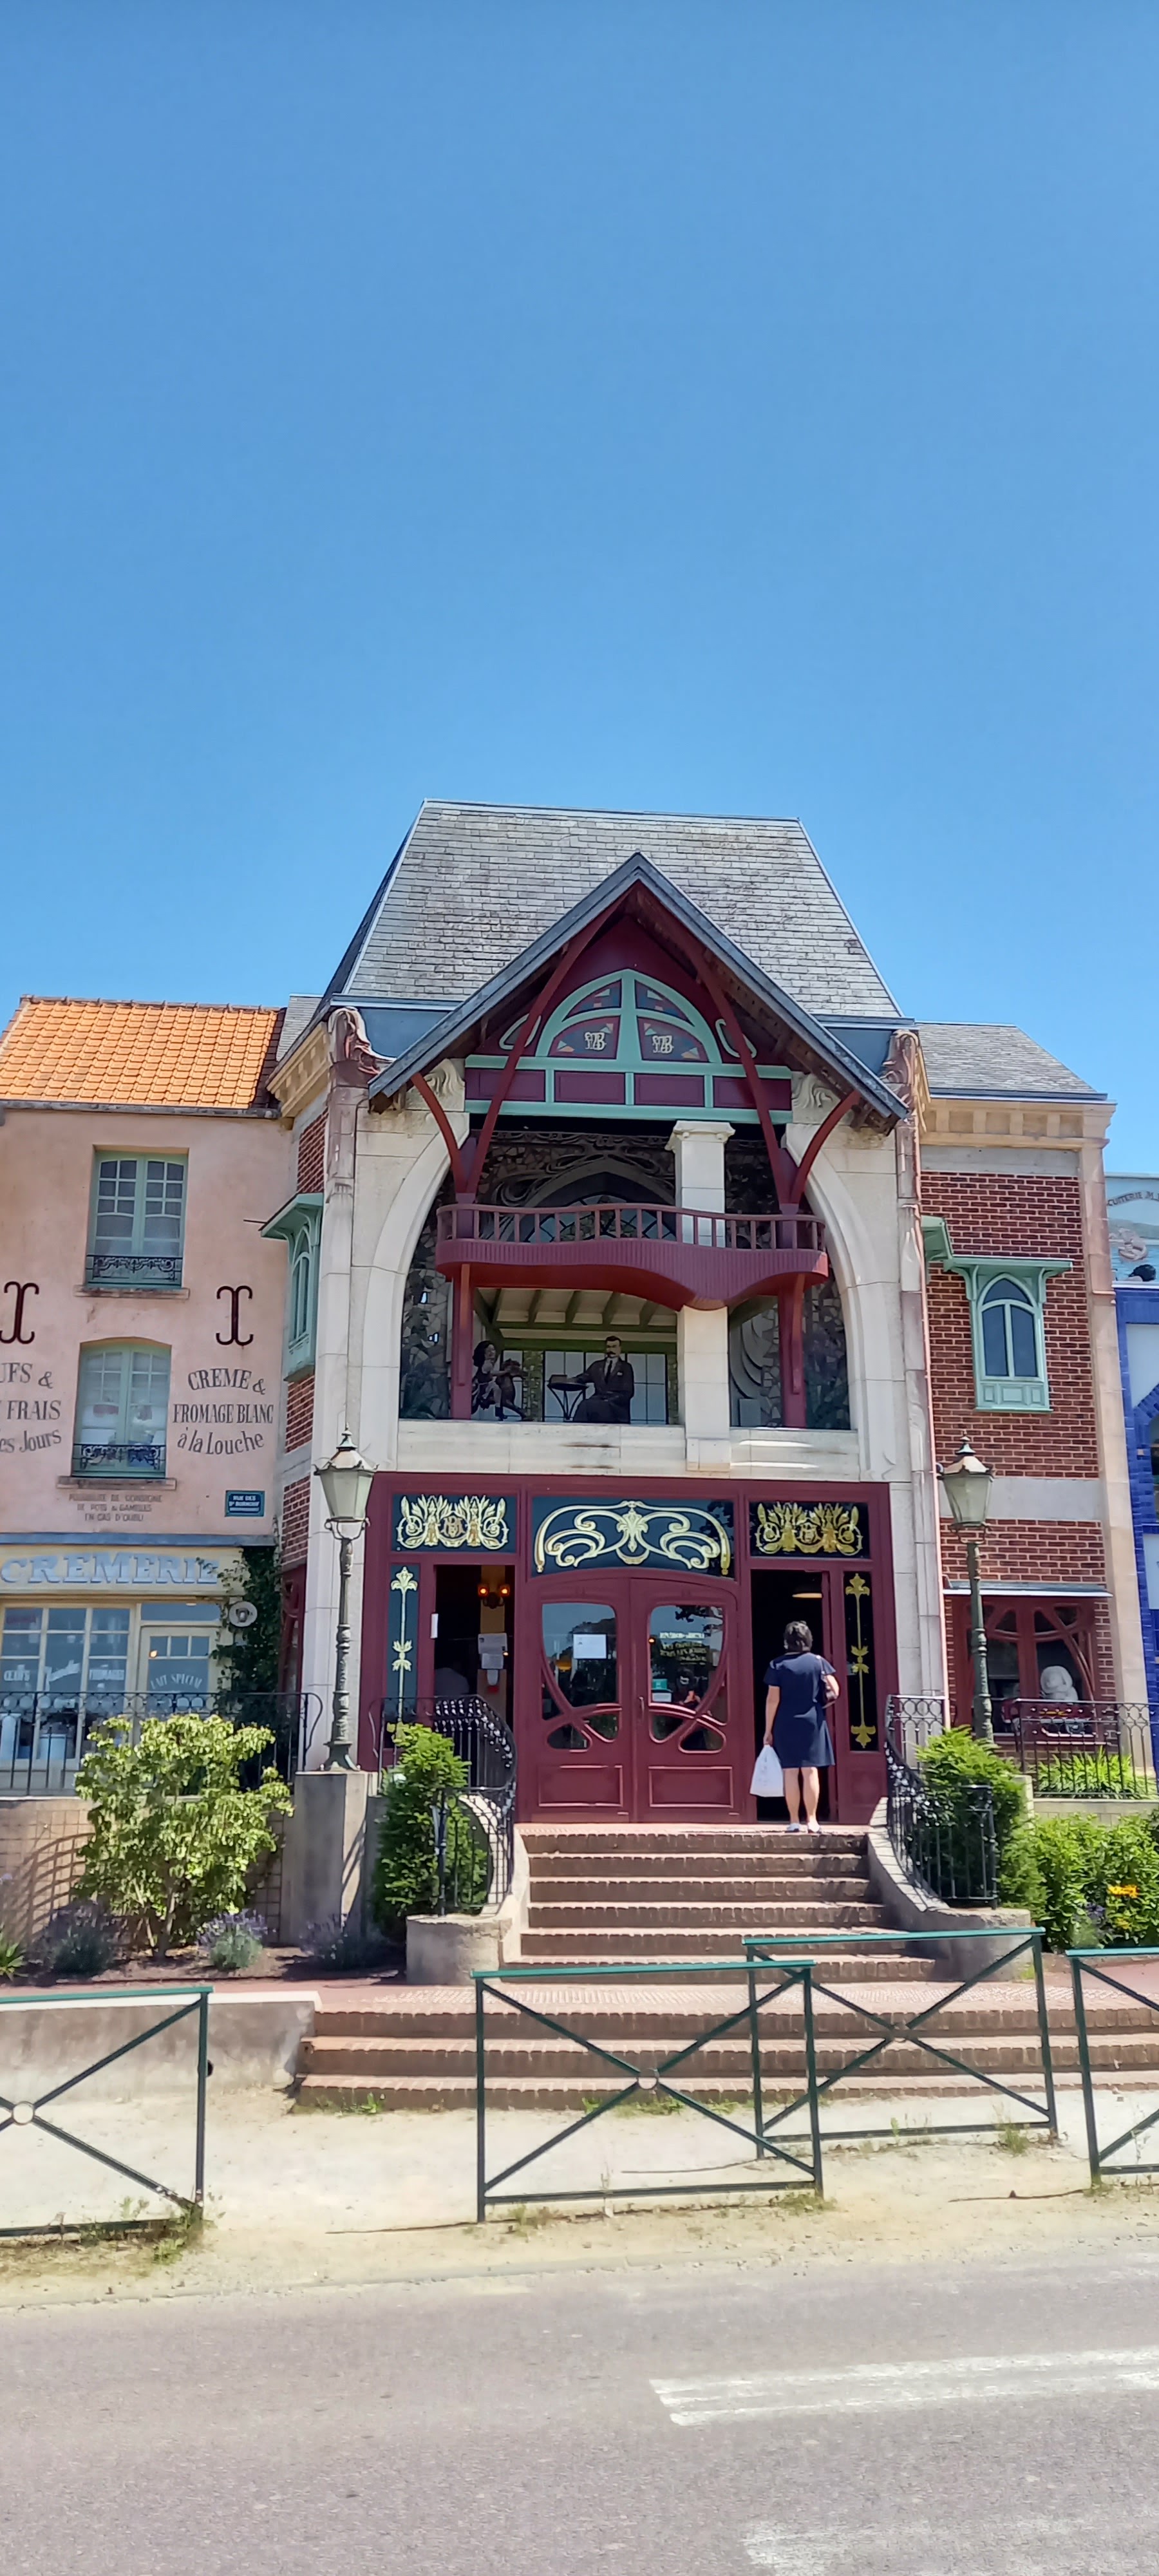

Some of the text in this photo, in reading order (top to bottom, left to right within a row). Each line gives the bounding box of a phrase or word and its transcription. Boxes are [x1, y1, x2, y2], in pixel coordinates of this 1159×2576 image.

[1107, 1191, 1144, 1206] CUITERIE
[37, 1371, 53, 1389] &
[188, 1368, 266, 1396] CREME &
[6, 1399, 62, 1421] FRAIS
[173, 1403, 274, 1424] FROMAGE BLANC
[19, 1429, 62, 1453] Jours
[188, 1429, 203, 1453] la
[1, 1551, 220, 1584] CREMERIE
